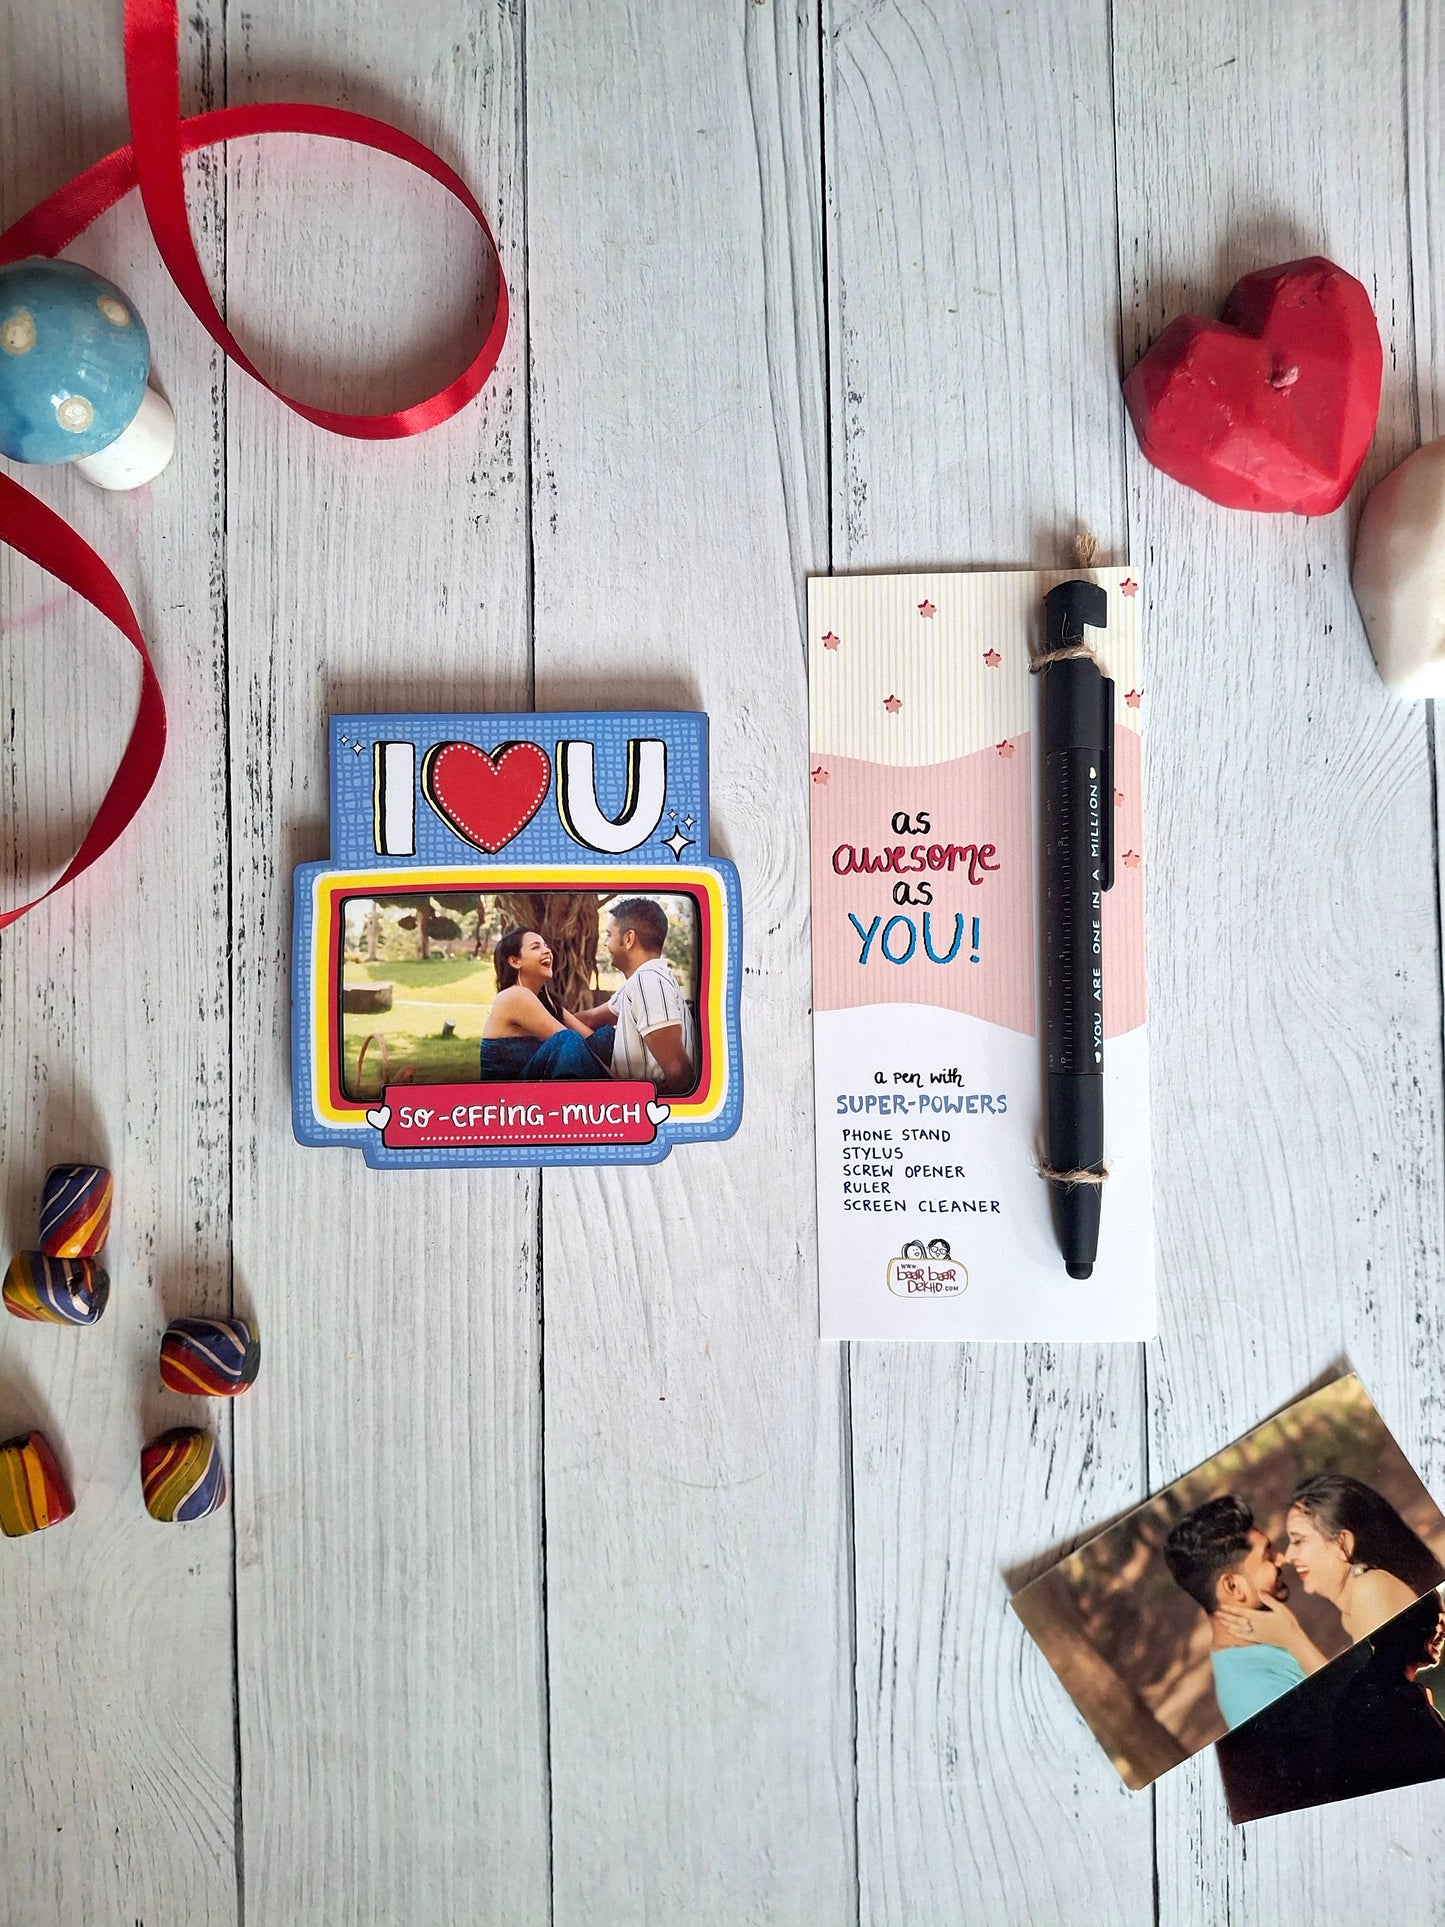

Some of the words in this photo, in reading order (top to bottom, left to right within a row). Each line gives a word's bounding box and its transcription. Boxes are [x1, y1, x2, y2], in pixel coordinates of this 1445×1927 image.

[373, 740, 415, 855] I
[556, 739, 667, 854] U
[891, 811, 931, 834] as
[1089, 785, 1099, 857] MILLION
[832, 844, 1000, 885] awesome
[1092, 869, 1099, 880] A
[892, 881, 933, 905] as
[1092, 892, 1100, 908] IN
[848, 912, 980, 964] YOU!
[1092, 920, 1100, 954] ONE
[1093, 968, 1101, 1001] ARE
[1094, 1012, 1102, 1047] YOU
[874, 1069, 887, 1085] a
[893, 1069, 924, 1088] pen
[930, 1067, 965, 1087] with
[836, 1094, 1008, 1115] SUPER-POWERS
[842, 1128, 893, 1142] PHONE
[902, 1128, 951, 1142] STAND
[842, 1146, 904, 1160] STYLUS
[843, 1164, 893, 1178] SCREW
[905, 1165, 965, 1178] OPENER
[843, 1181, 891, 1194] RULER
[843, 1199, 906, 1212] SCREEN
[918, 1199, 1000, 1213] CLEANER
